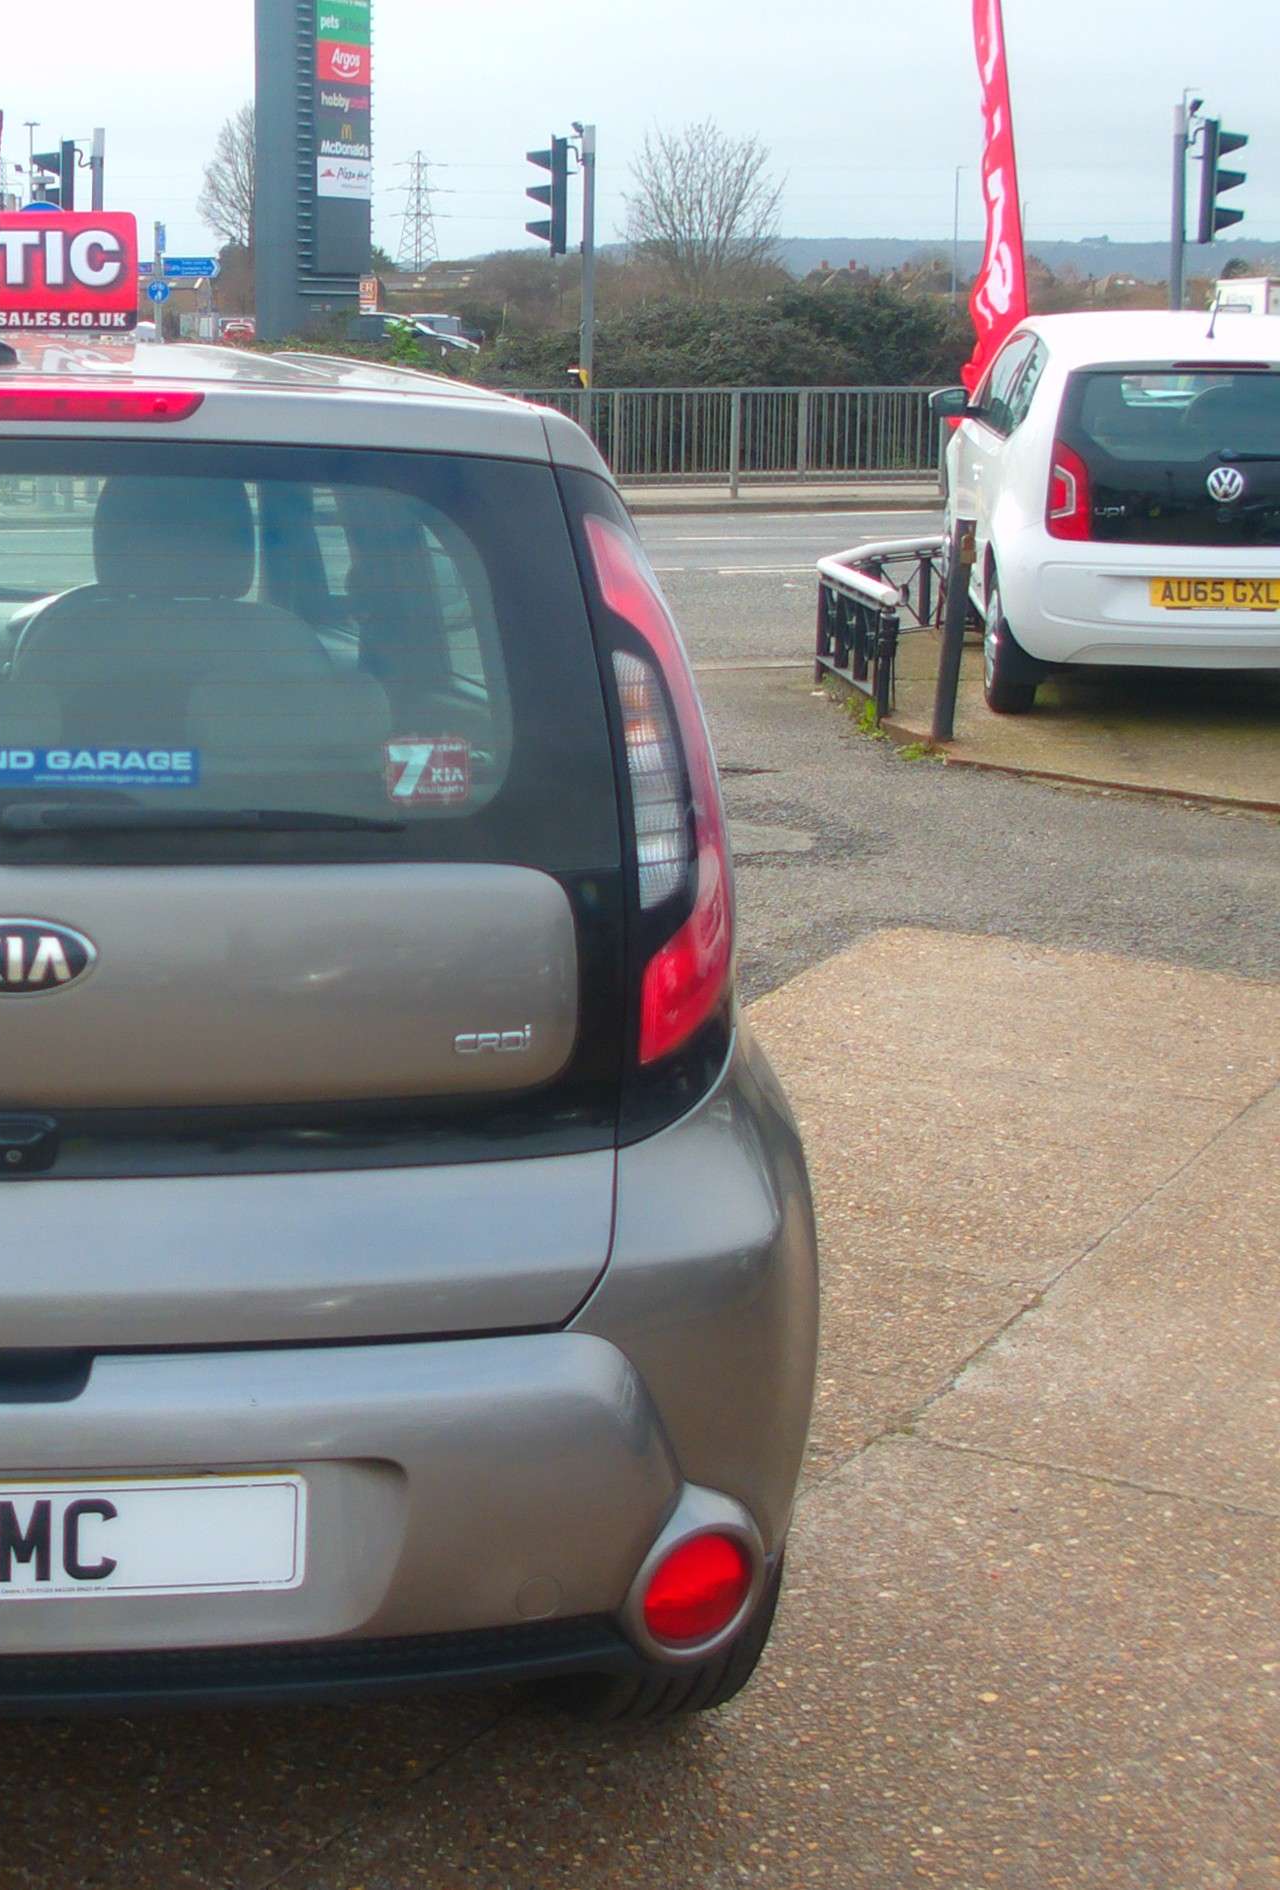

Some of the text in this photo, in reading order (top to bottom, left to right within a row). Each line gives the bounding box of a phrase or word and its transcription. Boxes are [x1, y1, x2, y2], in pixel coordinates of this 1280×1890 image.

[331, 48, 361, 70] Argos
[1160, 580, 1280, 604] AU65 GXL
[46, 750, 193, 771] GARAGE
[388, 744, 435, 797] 7
